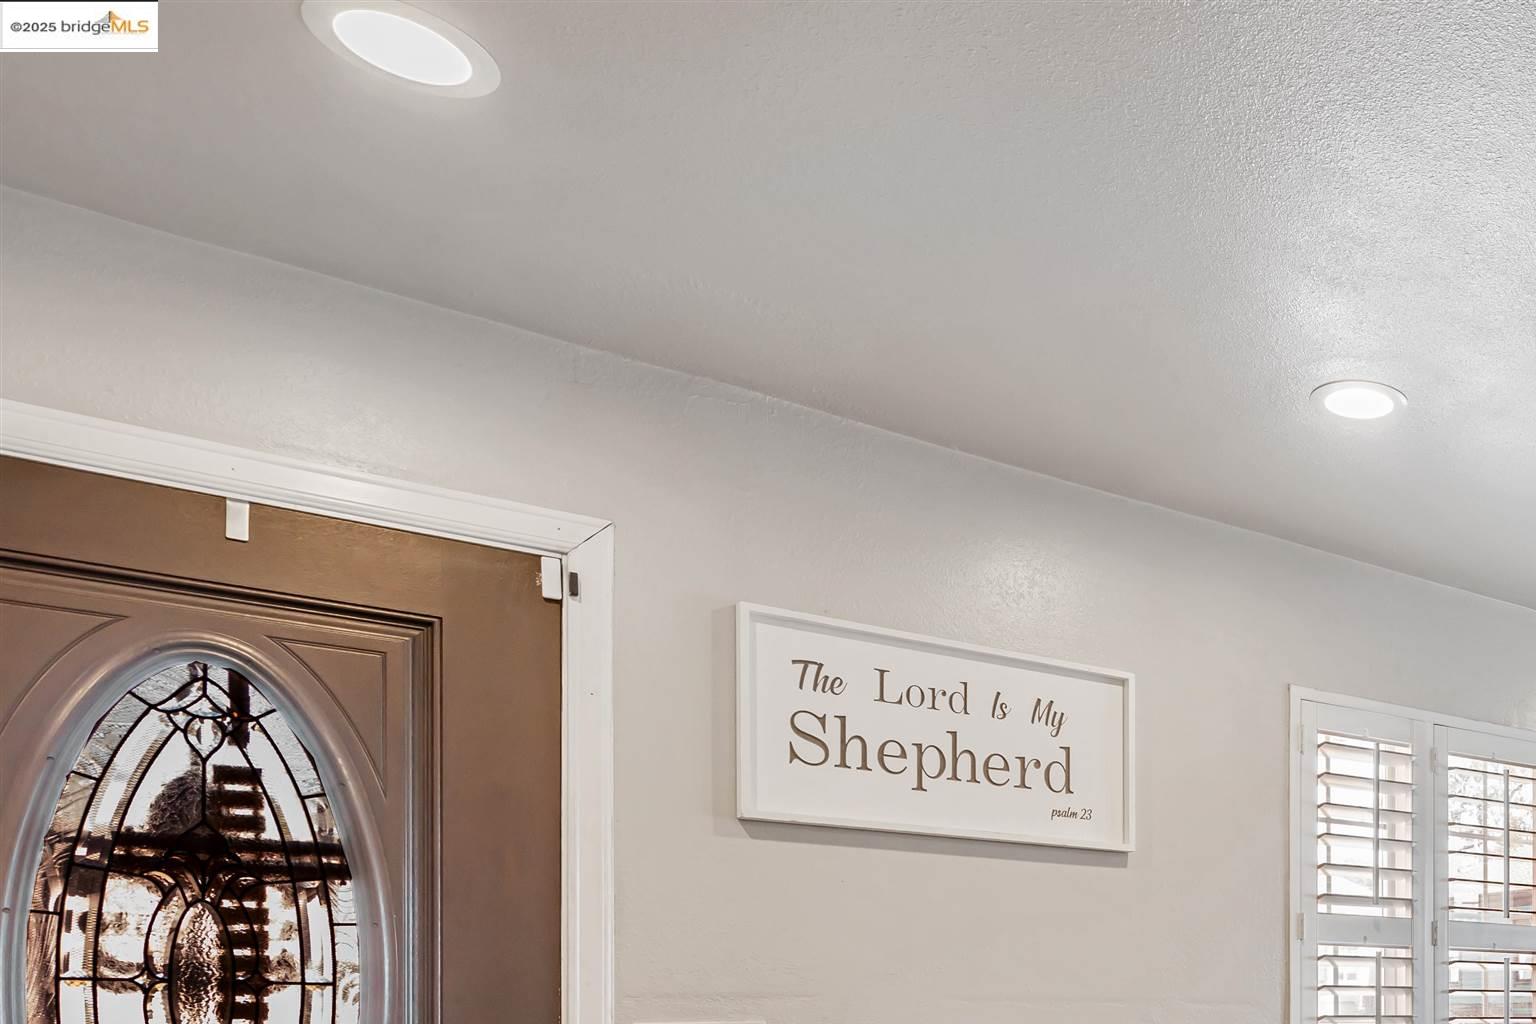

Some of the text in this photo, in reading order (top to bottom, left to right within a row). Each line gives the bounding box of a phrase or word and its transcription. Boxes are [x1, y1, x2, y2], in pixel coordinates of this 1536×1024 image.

[791, 659, 1068, 738] The Lord Is My
[788, 709, 1075, 795] Shepherd
[1050, 806, 1093, 821] psalm 23
